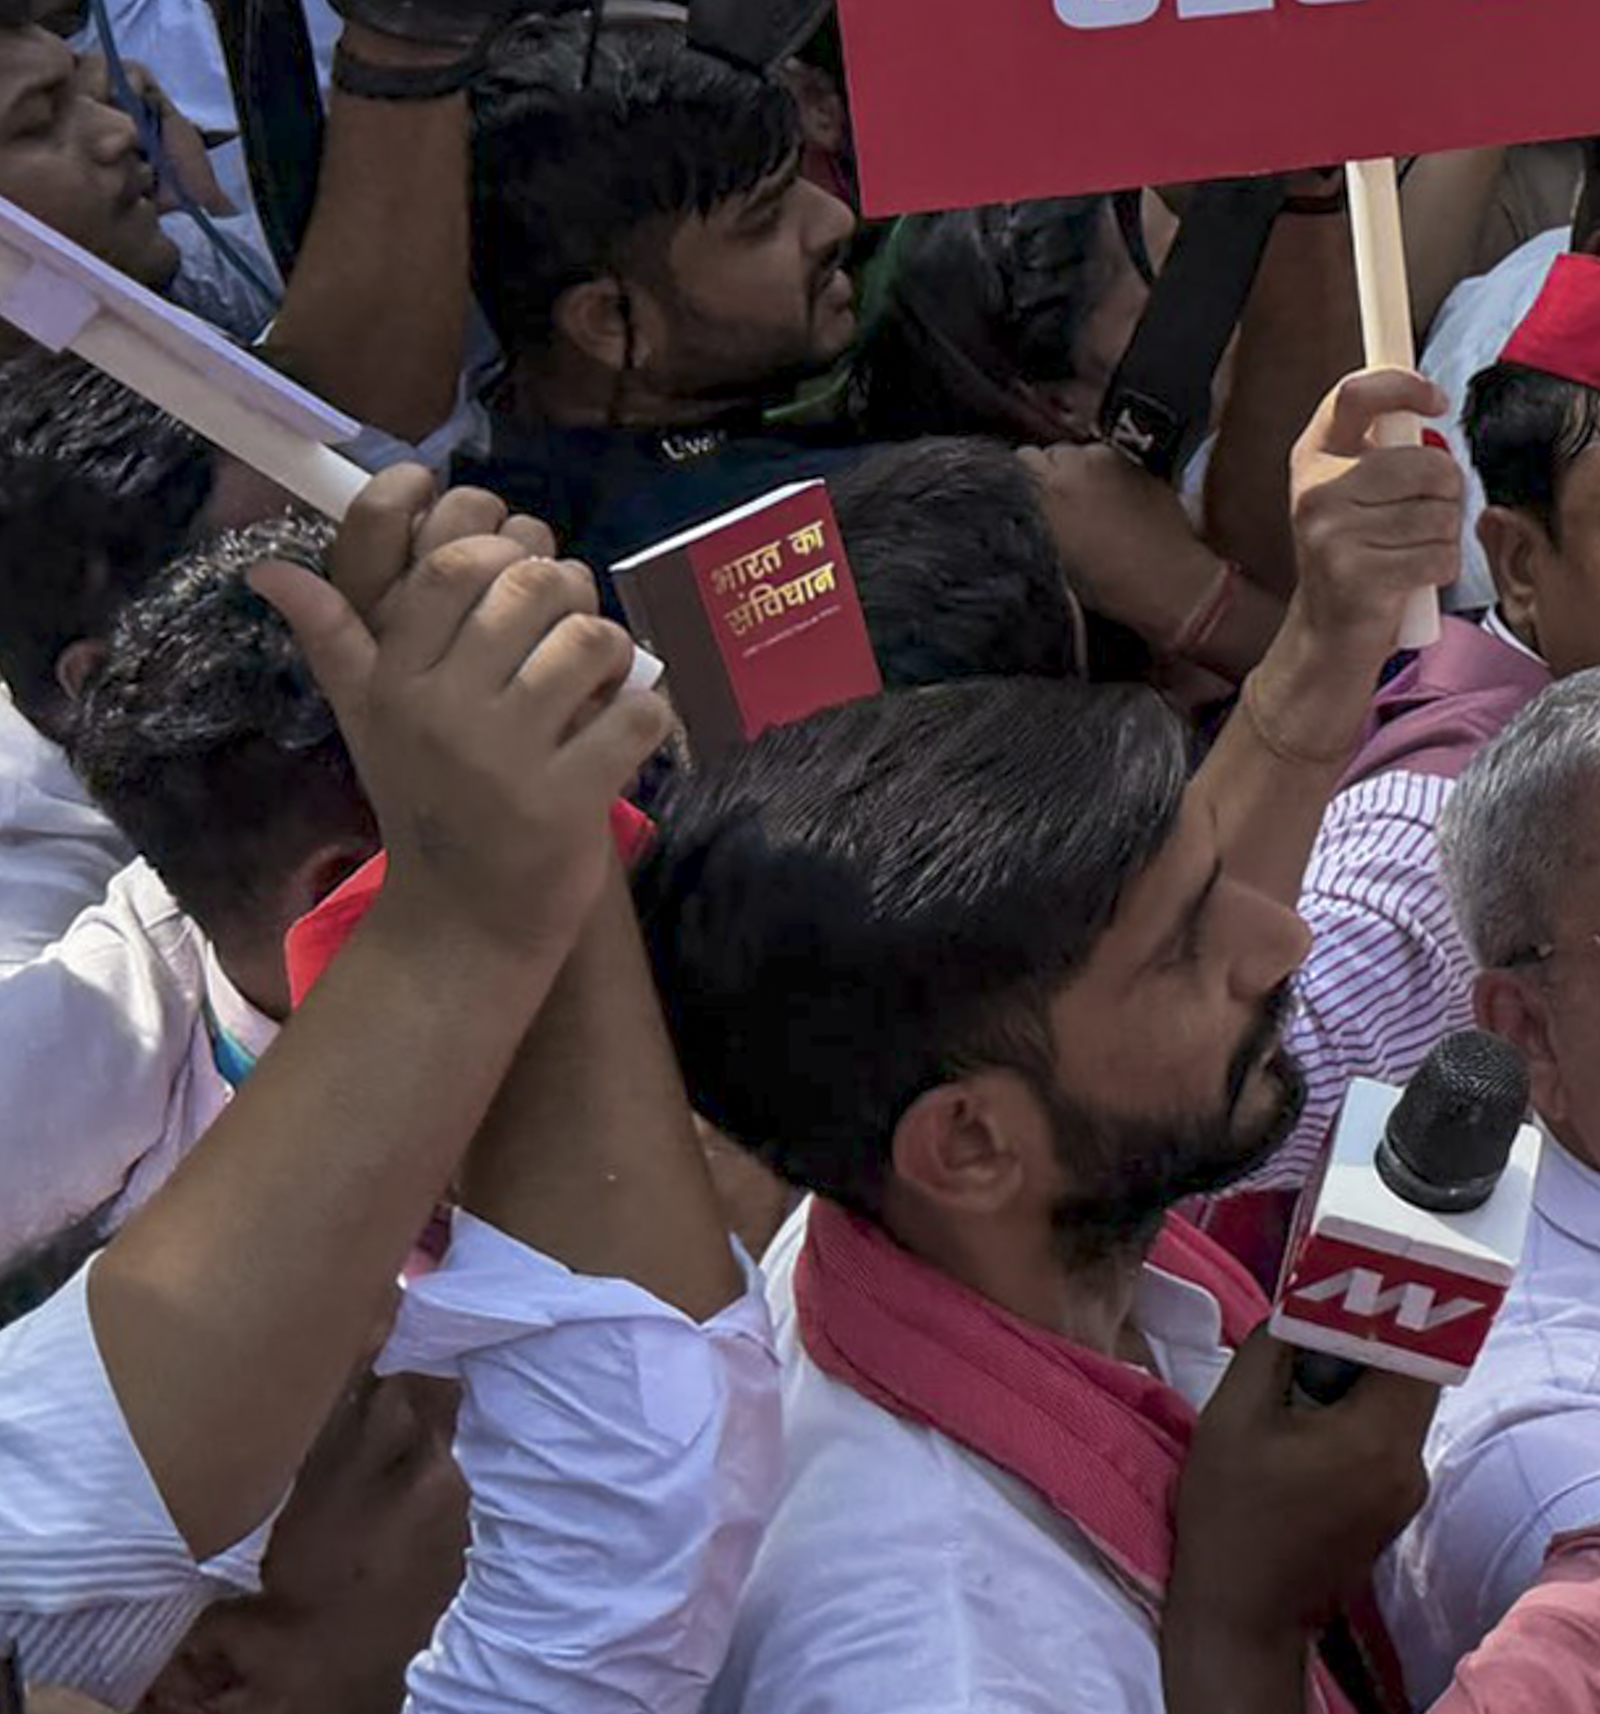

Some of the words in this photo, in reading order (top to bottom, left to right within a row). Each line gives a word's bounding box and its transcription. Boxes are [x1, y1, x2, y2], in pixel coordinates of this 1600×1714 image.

[711, 539, 782, 596] भारत
[786, 519, 825, 556] का
[724, 561, 836, 636] संविधान
